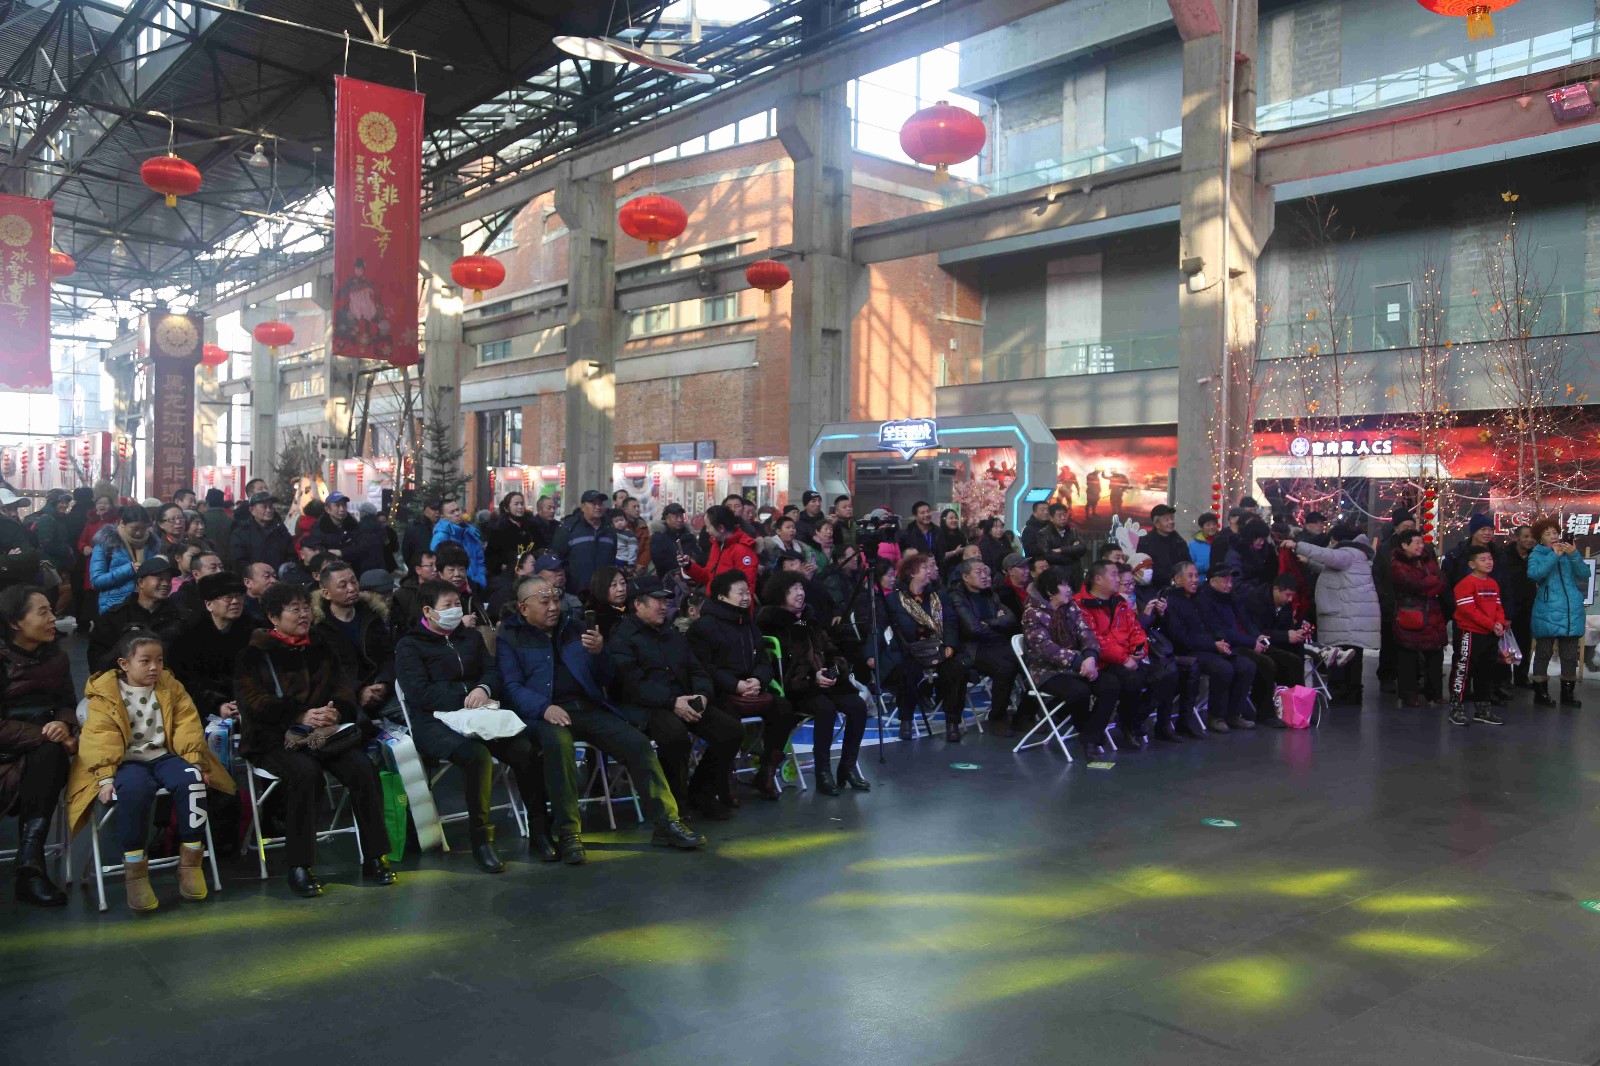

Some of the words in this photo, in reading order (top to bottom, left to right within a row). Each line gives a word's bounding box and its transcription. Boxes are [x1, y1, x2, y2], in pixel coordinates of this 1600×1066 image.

[360, 154, 400, 258] 冰雪非遗节
[1566, 512, 1600, 536] 镭
